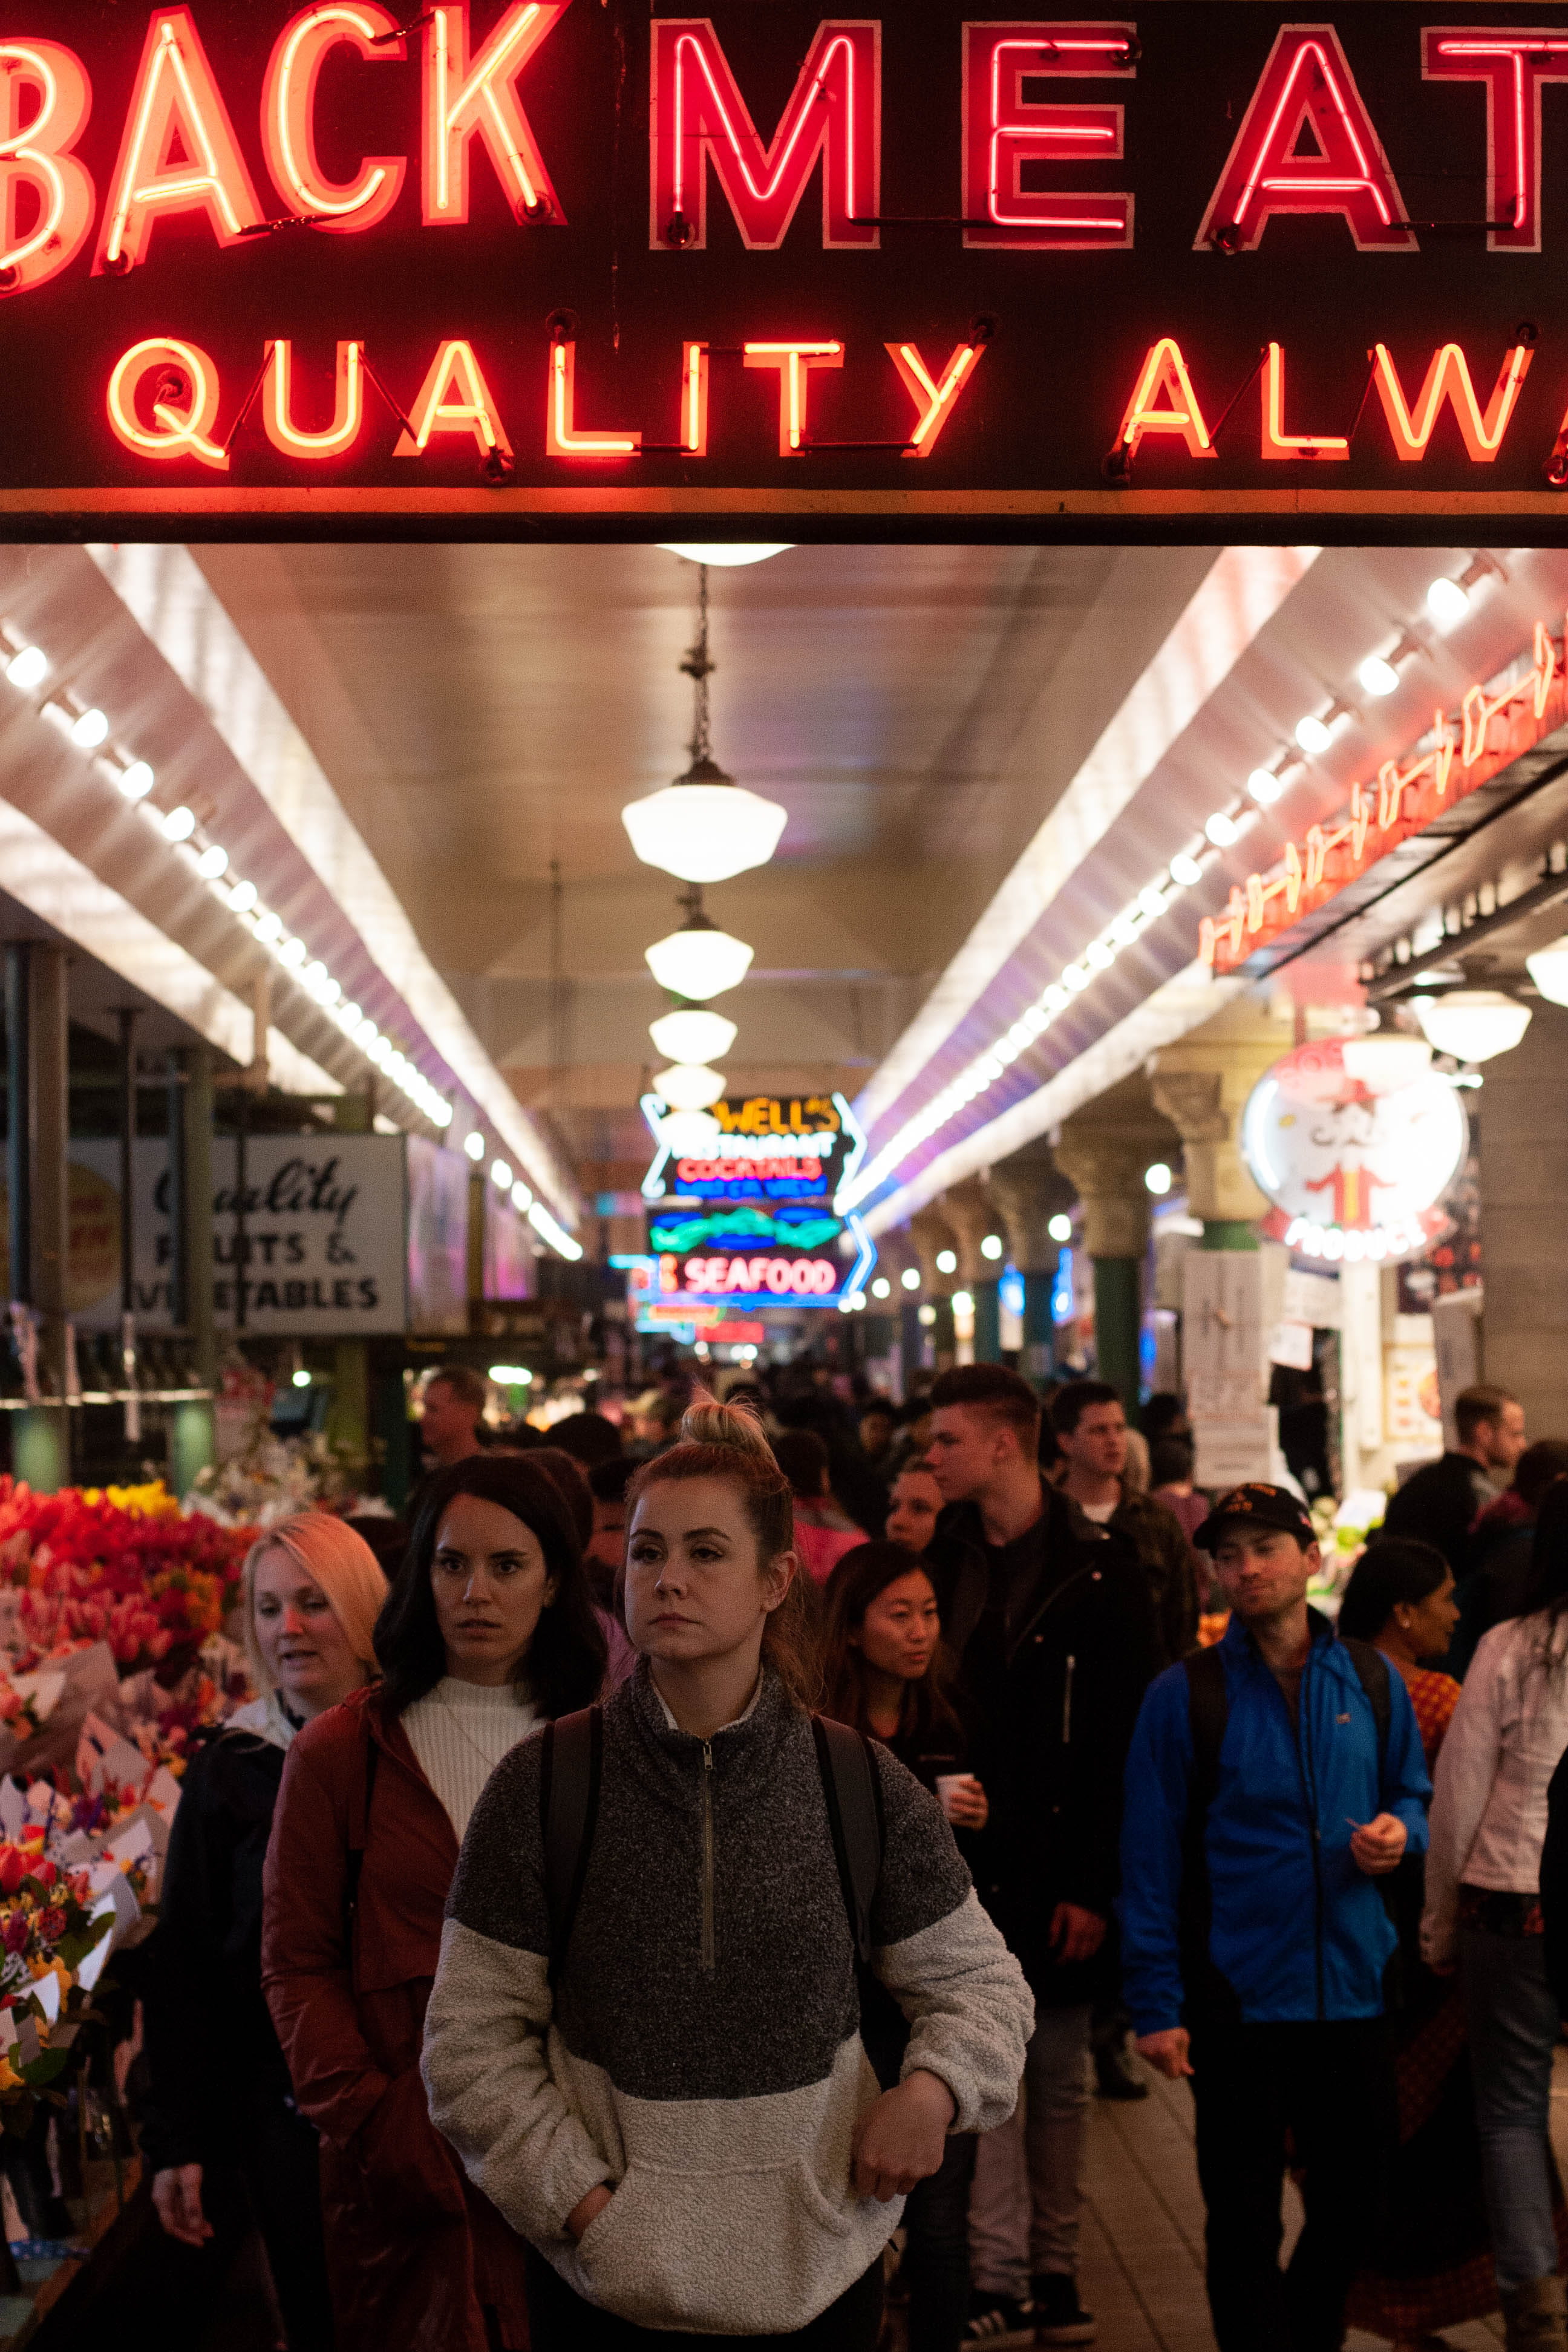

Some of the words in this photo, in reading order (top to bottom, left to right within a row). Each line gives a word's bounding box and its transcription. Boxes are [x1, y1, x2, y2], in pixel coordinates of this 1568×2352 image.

[107, 337, 986, 471] QUALITY
[1119, 338, 1568, 478] ALW
[670, 1097, 840, 1134] WELL'S
[685, 1258, 836, 1294] SEAFOOD
